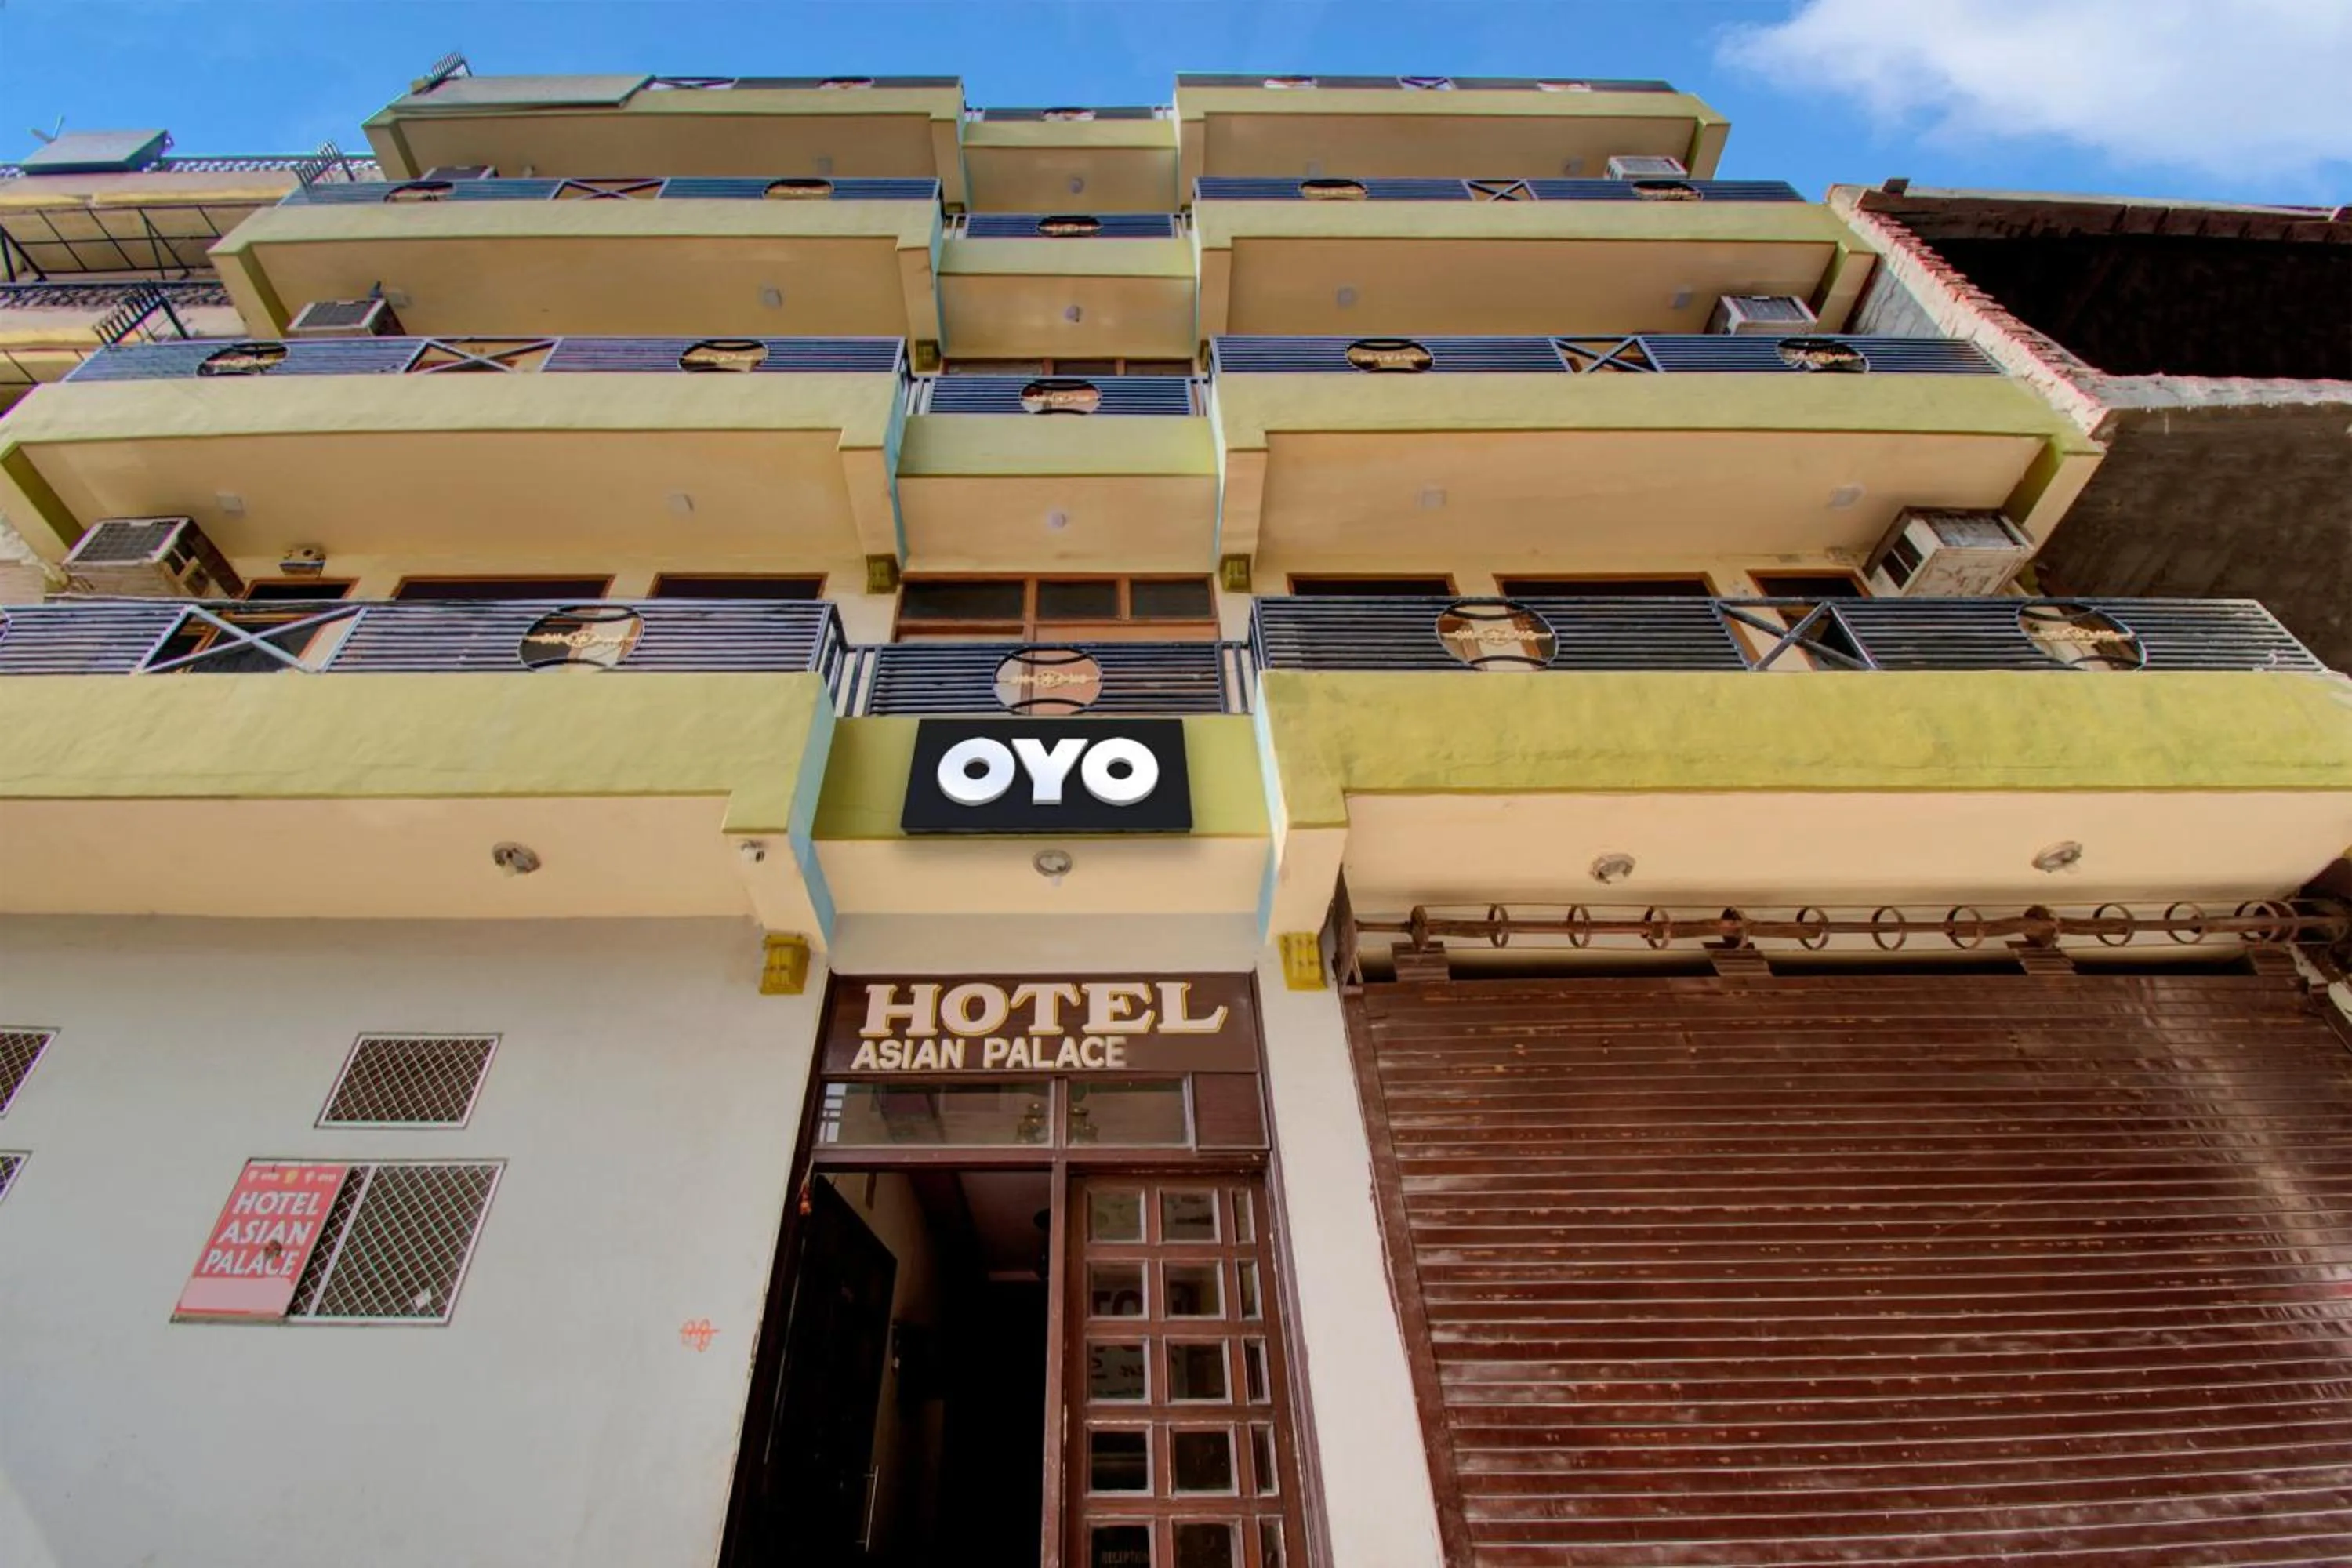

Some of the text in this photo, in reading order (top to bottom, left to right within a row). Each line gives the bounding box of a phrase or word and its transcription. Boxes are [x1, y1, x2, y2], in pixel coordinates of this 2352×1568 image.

[937, 737, 1159, 806] OYO
[859, 982, 1229, 1036] HOTEL
[851, 1036, 1127, 1070] ASIAN PALACE
[234, 1192, 320, 1214] HOTEL
[218, 1221, 313, 1245] ASIAN
[201, 1250, 299, 1276] PALACE
